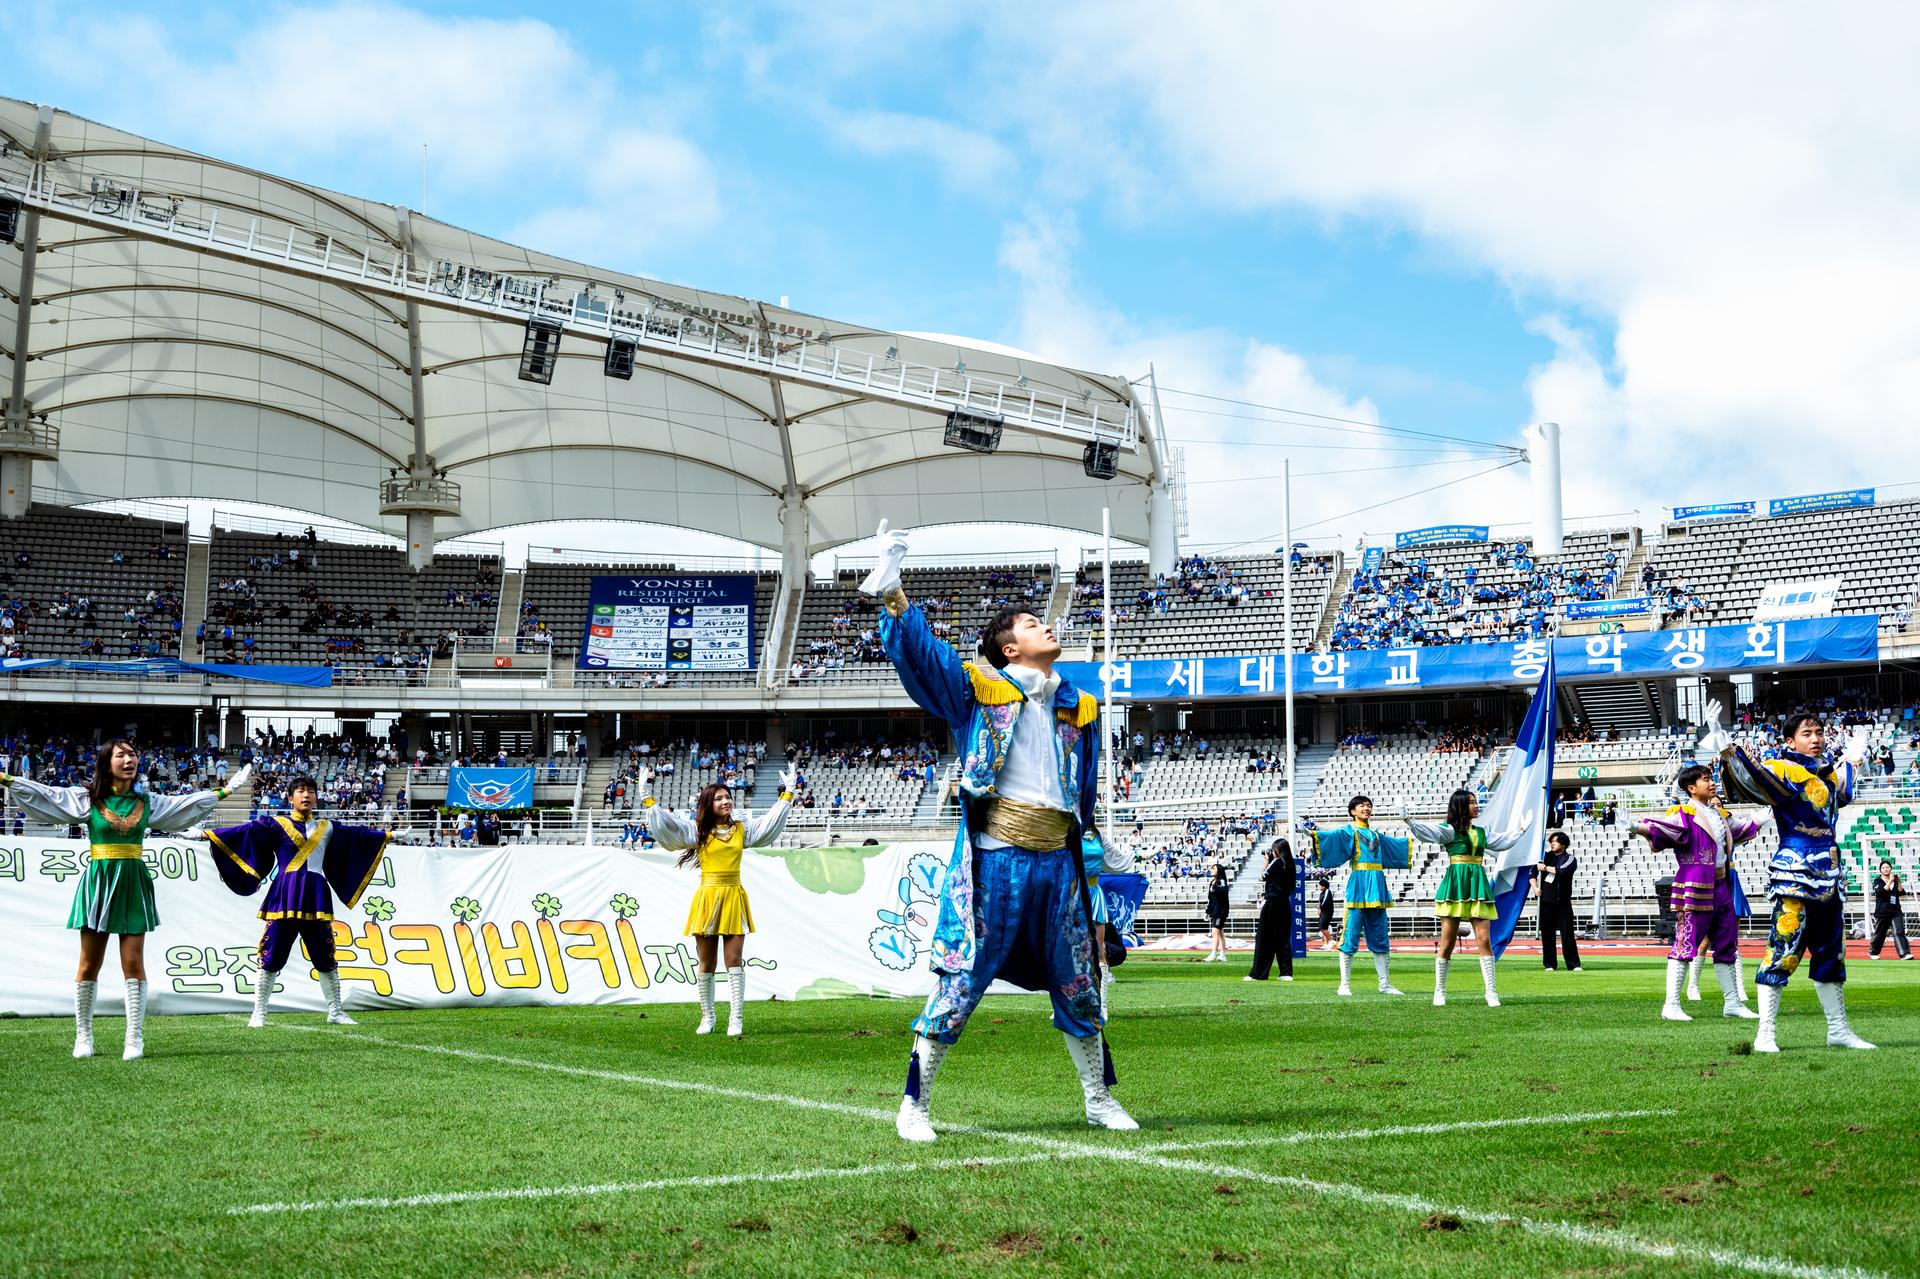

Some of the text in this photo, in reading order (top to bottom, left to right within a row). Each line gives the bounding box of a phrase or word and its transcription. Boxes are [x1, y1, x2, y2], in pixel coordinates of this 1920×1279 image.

[630, 580, 713, 588] YONSEI
[1098, 624, 1786, 698] 연세대학교 총학생회
[1578, 766, 1598, 779] N2
[918, 864, 938, 889] Y
[878, 934, 906, 960] Y
